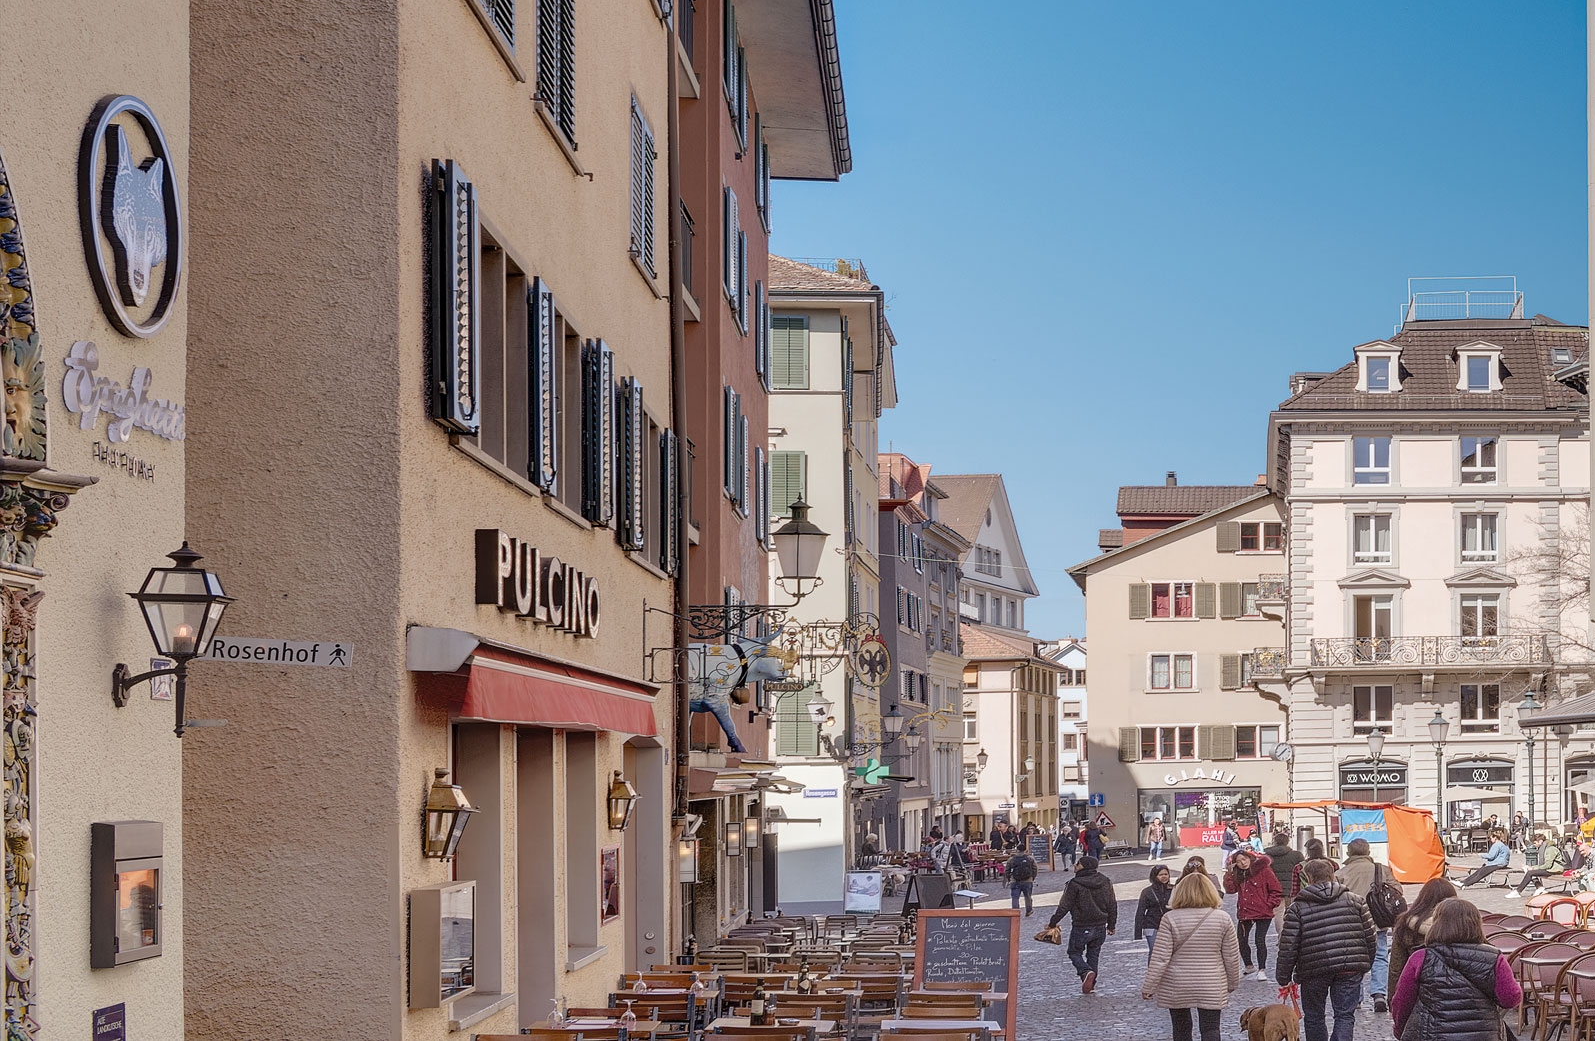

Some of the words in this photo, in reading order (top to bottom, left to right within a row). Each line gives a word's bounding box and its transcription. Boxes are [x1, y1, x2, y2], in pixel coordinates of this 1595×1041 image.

[494, 529, 600, 639] PULCINO
[212, 640, 320, 663] Rosenhof
[765, 683, 804, 692] PULCINO
[1164, 767, 1236, 786] GIAHI
[1359, 772, 1401, 783] WOMO
